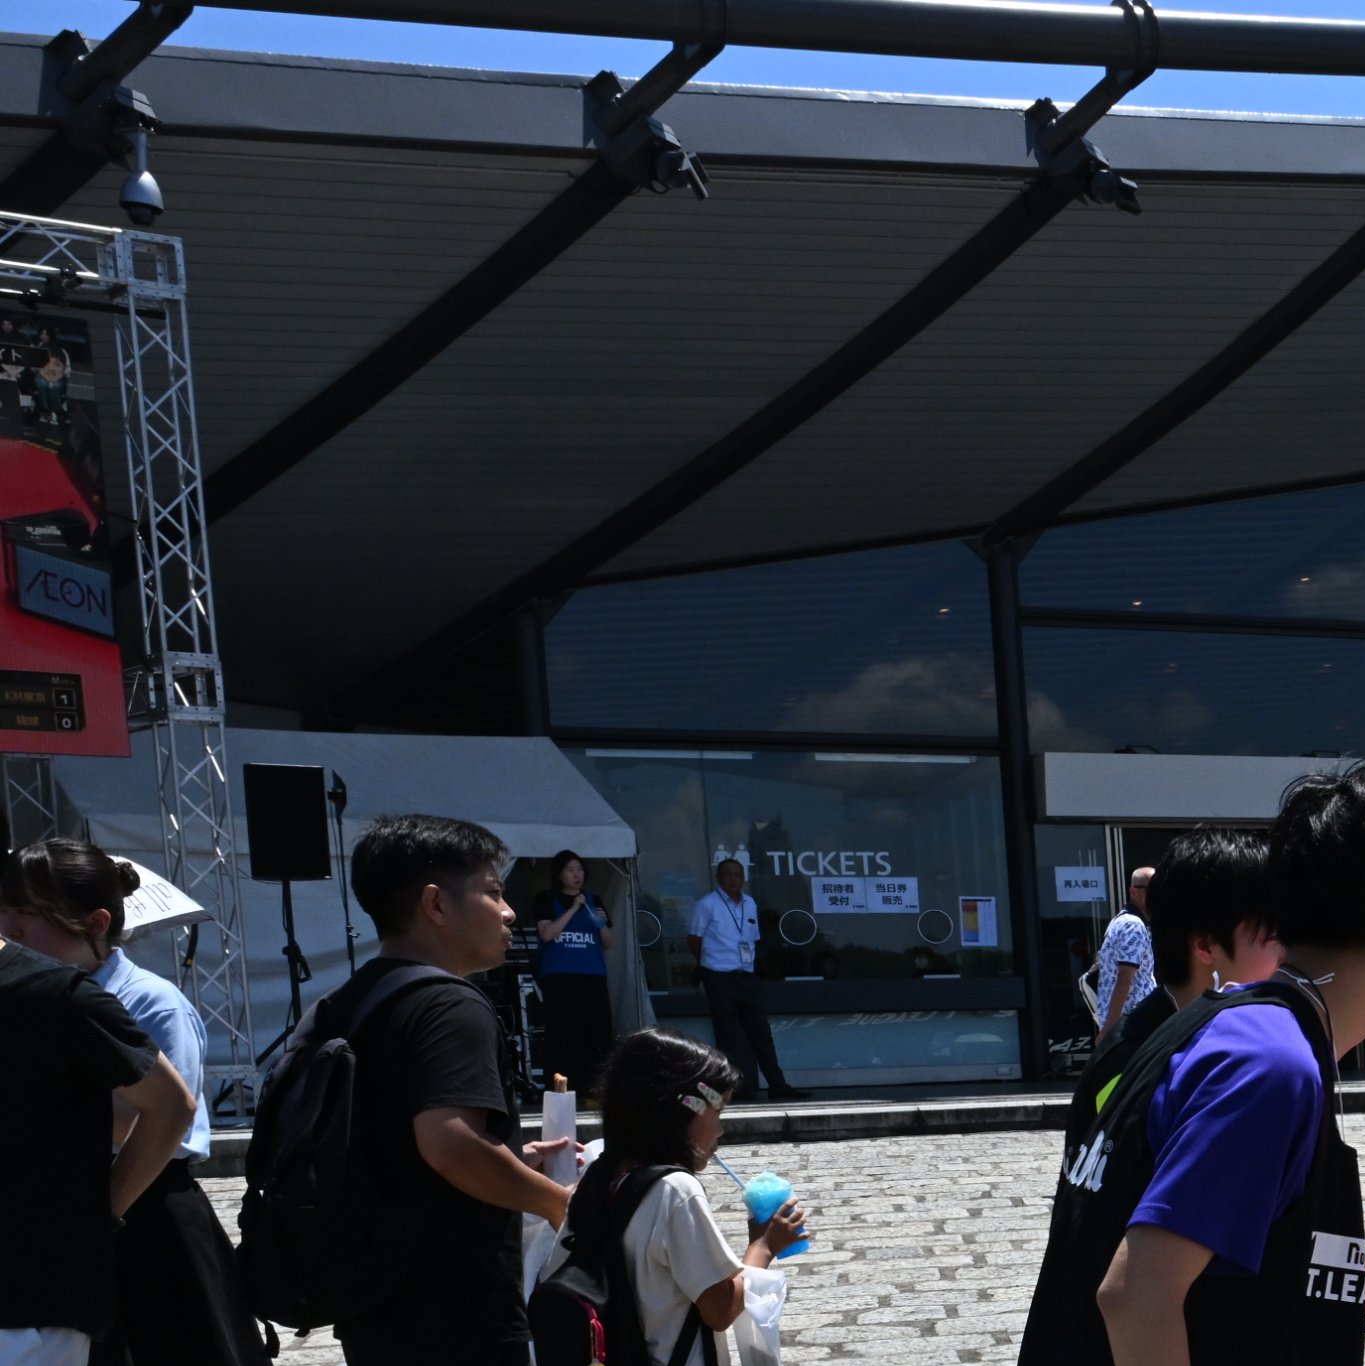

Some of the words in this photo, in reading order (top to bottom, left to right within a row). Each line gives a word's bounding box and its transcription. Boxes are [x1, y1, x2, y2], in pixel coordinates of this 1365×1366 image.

[766, 851, 892, 876] TICKETS
[822, 883, 854, 894] 招待者
[875, 883, 907, 894] 当日券
[828, 896, 850, 906] 受付
[881, 895, 903, 905] 販売
